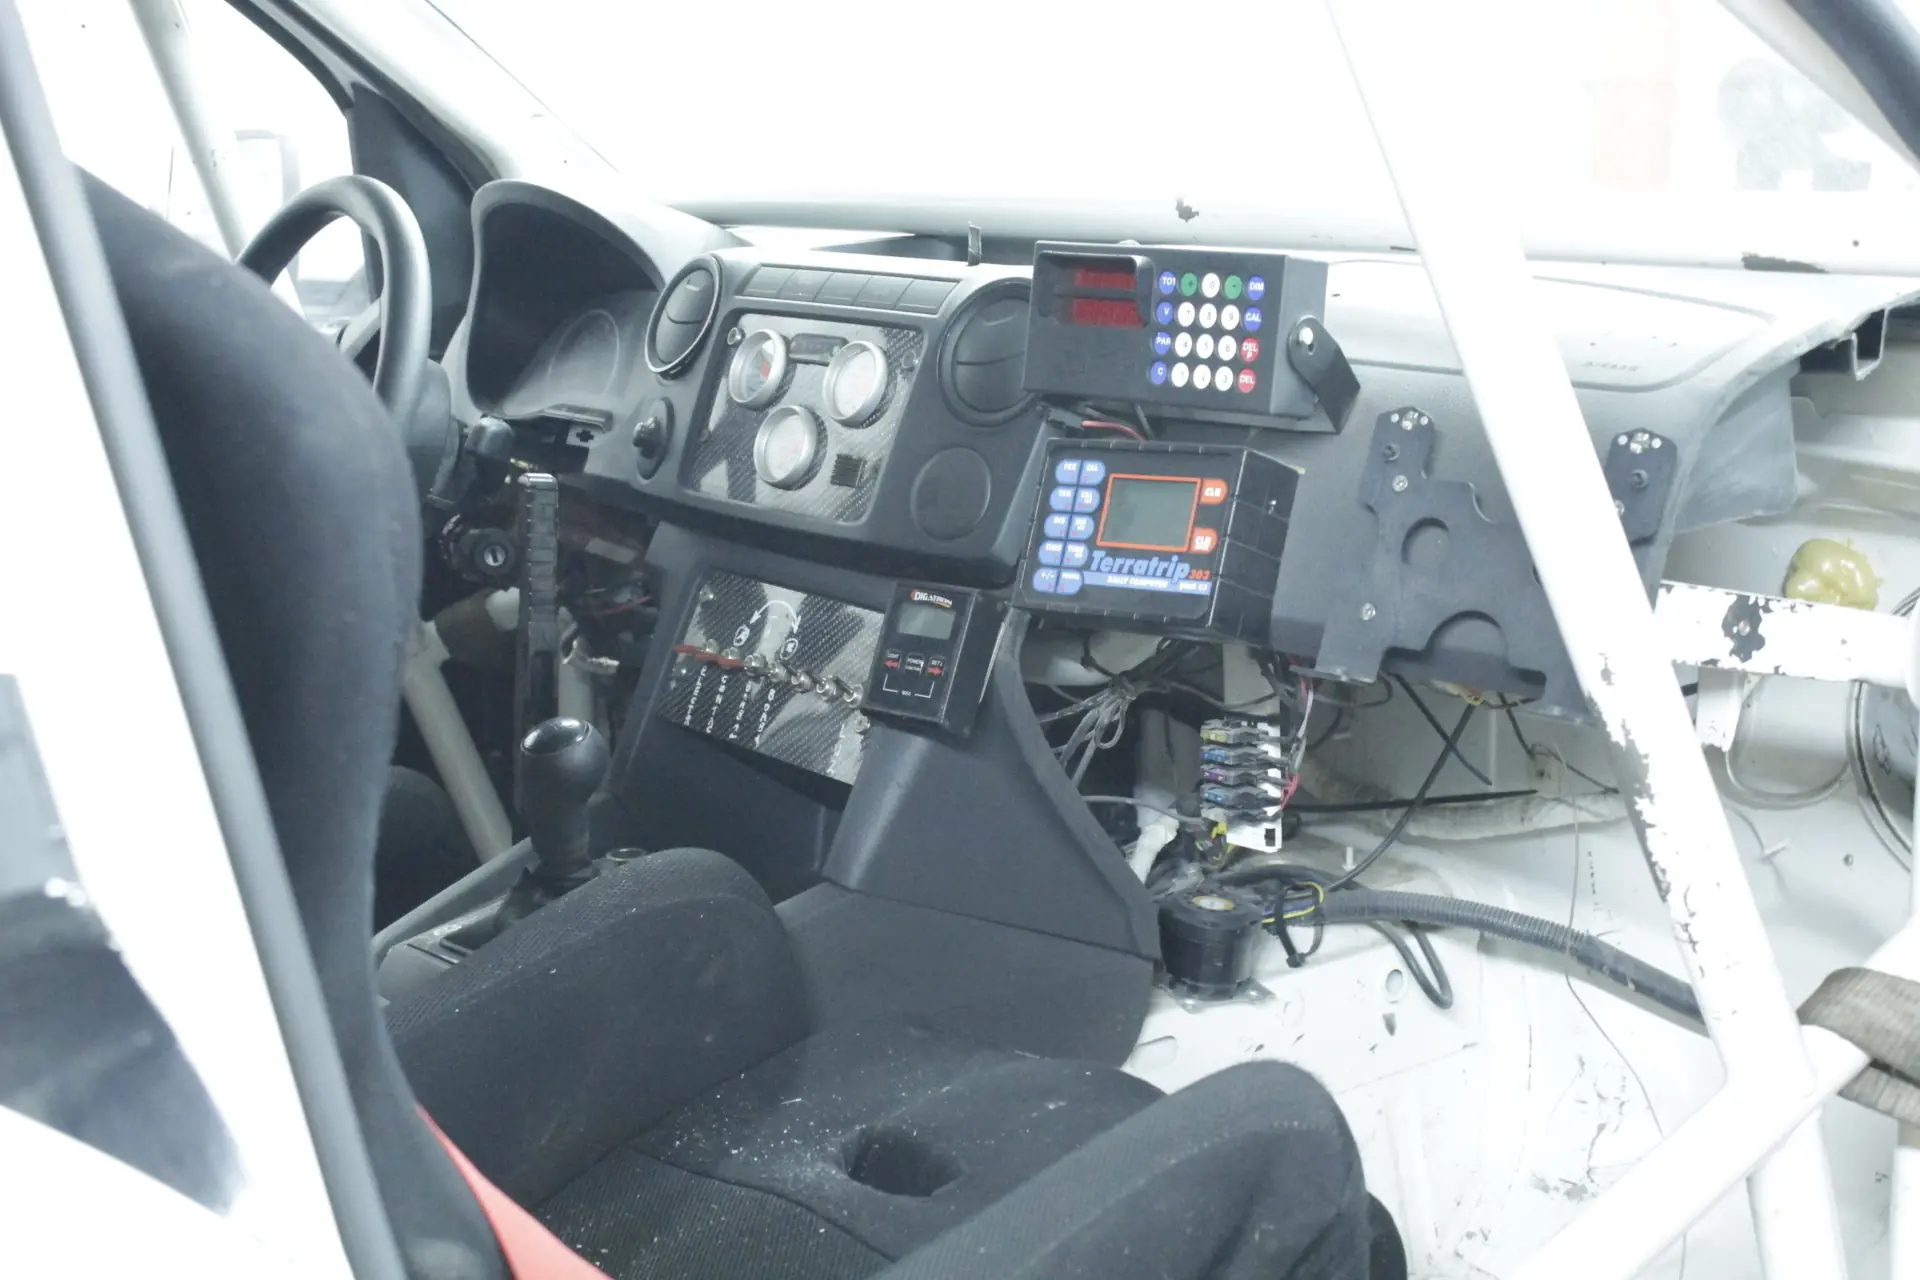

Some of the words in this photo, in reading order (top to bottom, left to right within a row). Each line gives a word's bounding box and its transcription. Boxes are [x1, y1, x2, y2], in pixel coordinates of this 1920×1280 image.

[1162, 276, 1176, 285] TOT
[1249, 282, 1264, 291] DIM
[1246, 313, 1262, 322] CAL
[1156, 336, 1171, 345] PAR
[1242, 343, 1258, 352] DEL
[1239, 375, 1255, 384] DEL
[1090, 550, 1190, 583] Terratrip
[1189, 568, 1210, 580] 303
